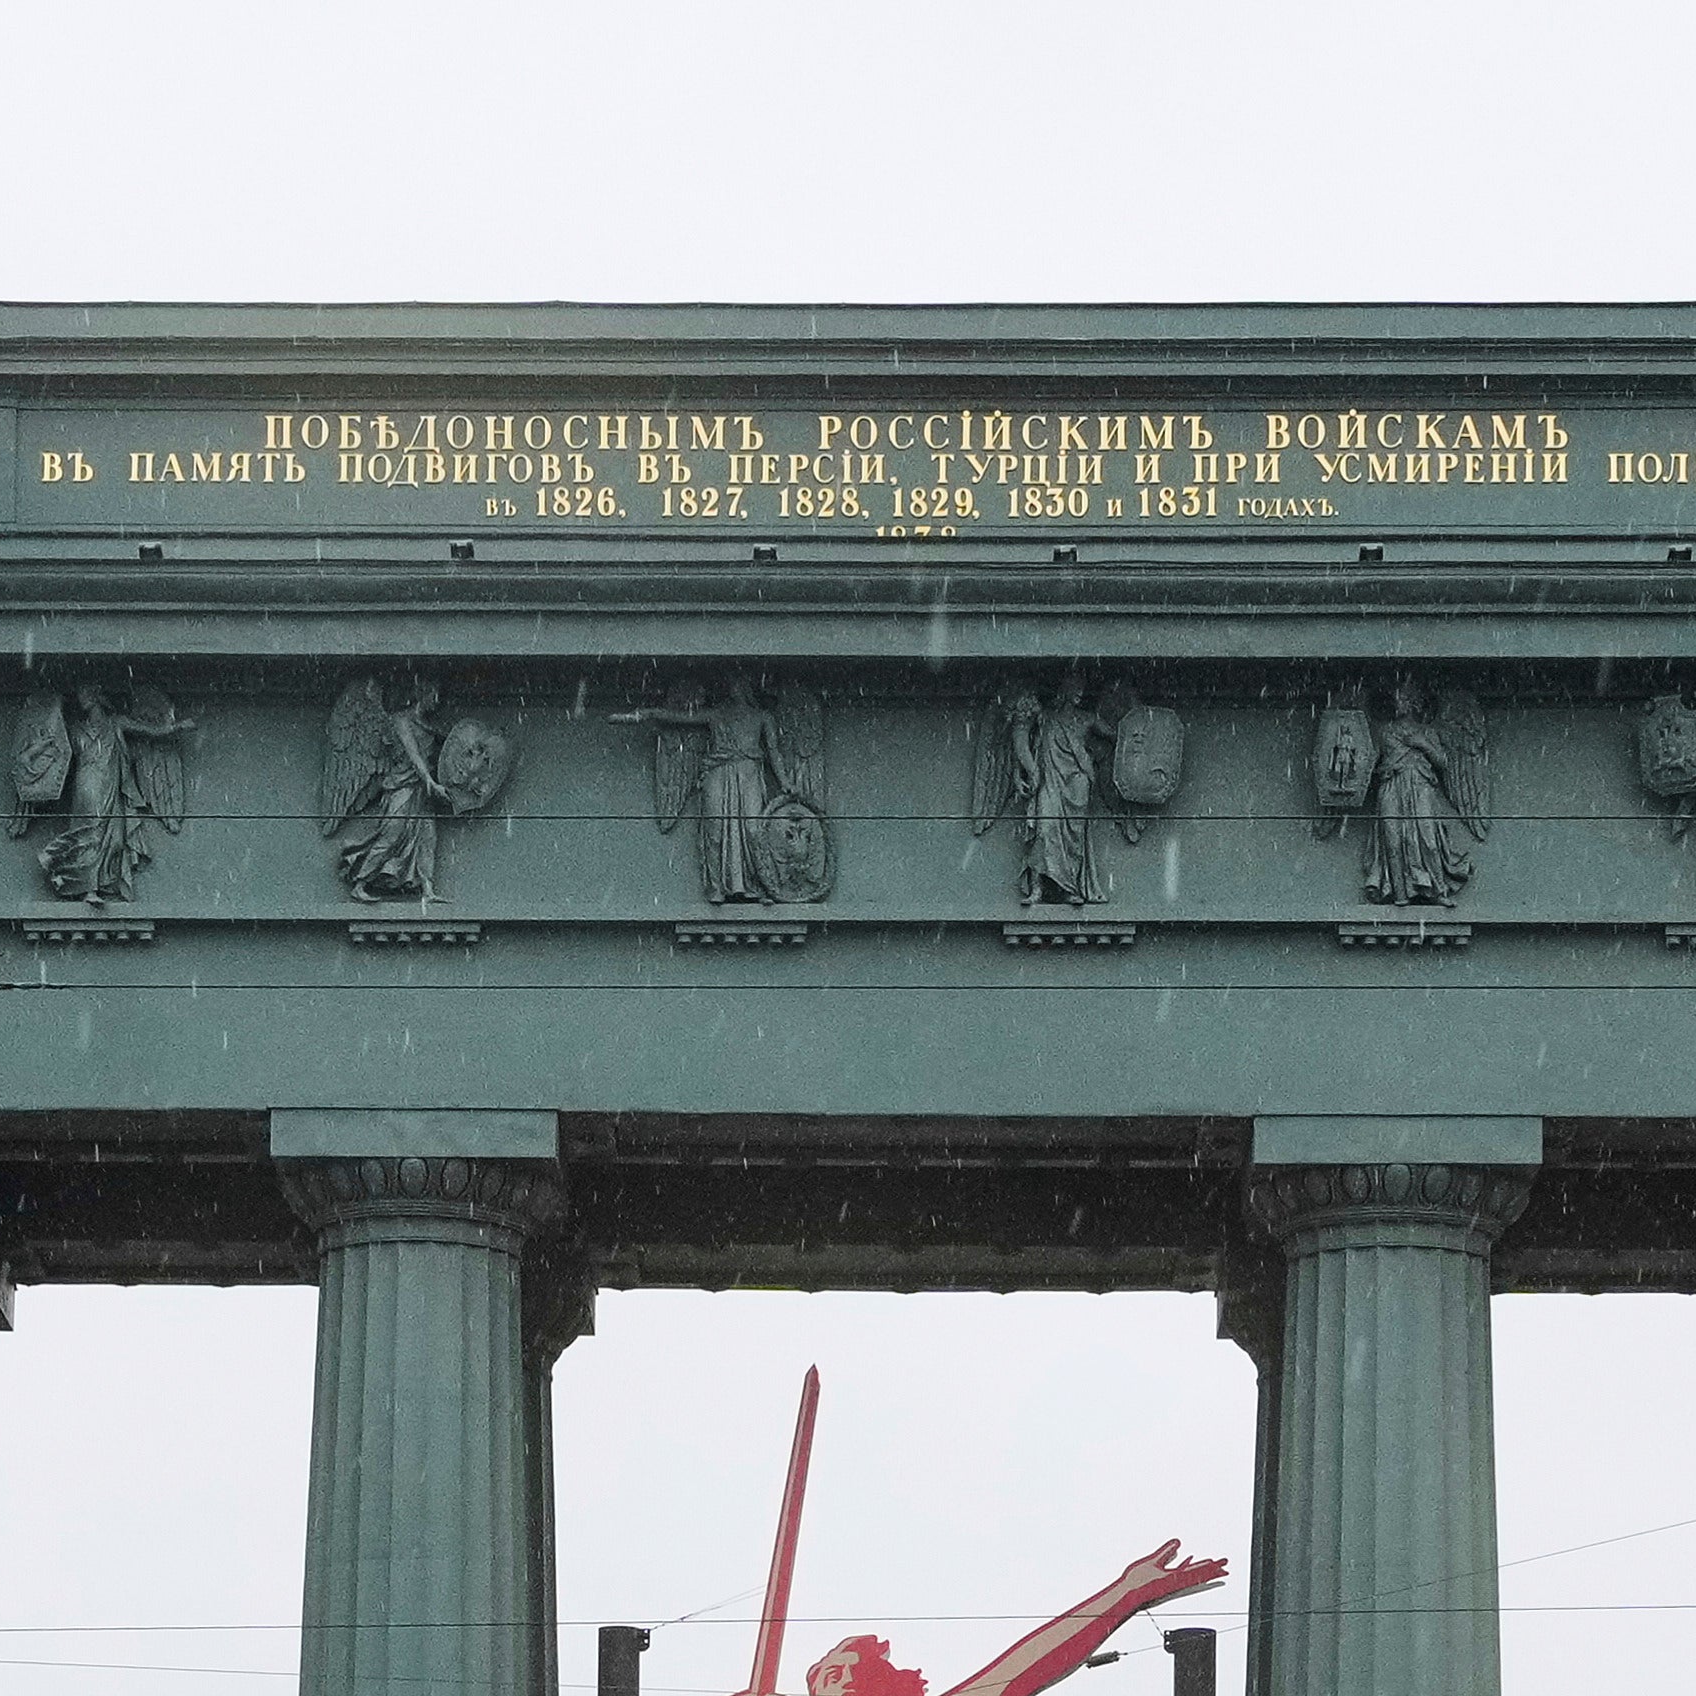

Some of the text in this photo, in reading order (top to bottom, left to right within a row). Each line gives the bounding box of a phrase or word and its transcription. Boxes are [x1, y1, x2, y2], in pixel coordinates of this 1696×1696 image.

[264, 408, 1570, 453] ПОБѢДОНОСНЫМЪ РОССІЙСКИМЪ ВОЙСКАМЪ
[40, 452, 95, 483] ВЪ
[127, 452, 306, 484] ПАМЯТЬ
[336, 452, 595, 488] ПОДВИГОВЪ
[636, 453, 692, 484] ВЪ
[1133, 453, 1162, 484] И
[1191, 453, 1282, 484] ПРИ
[1312, 447, 1569, 484] УСМИРЕНІИ
[535, 486, 628, 518] 1826,
[661, 486, 749, 519] 1827,
[778, 486, 870, 519] 1828,
[891, 487, 981, 519] 1829,
[1008, 487, 1090, 518] 1830
[1138, 485, 1219, 518] 1831
